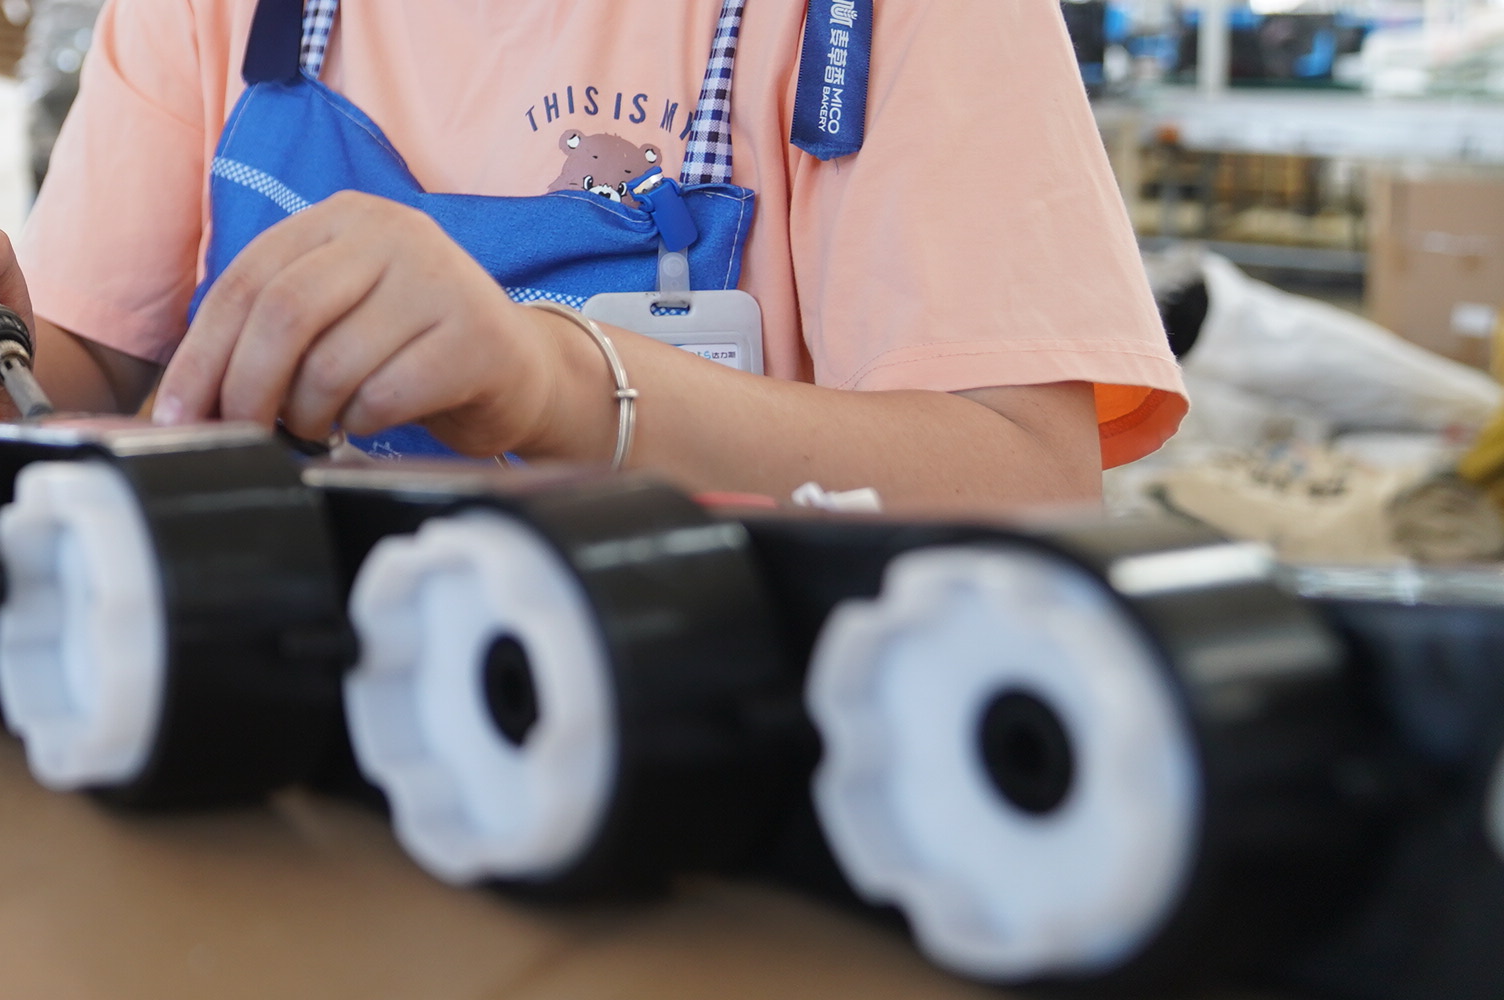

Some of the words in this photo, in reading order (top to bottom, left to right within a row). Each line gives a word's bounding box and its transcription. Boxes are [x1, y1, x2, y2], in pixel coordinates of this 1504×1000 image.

[824, 28, 850, 86] 麦草香
[525, 86, 599, 132] THIS
[613, 93, 648, 124] IS
[818, 86, 831, 133] BAKERY
[827, 87, 844, 135] MICO
